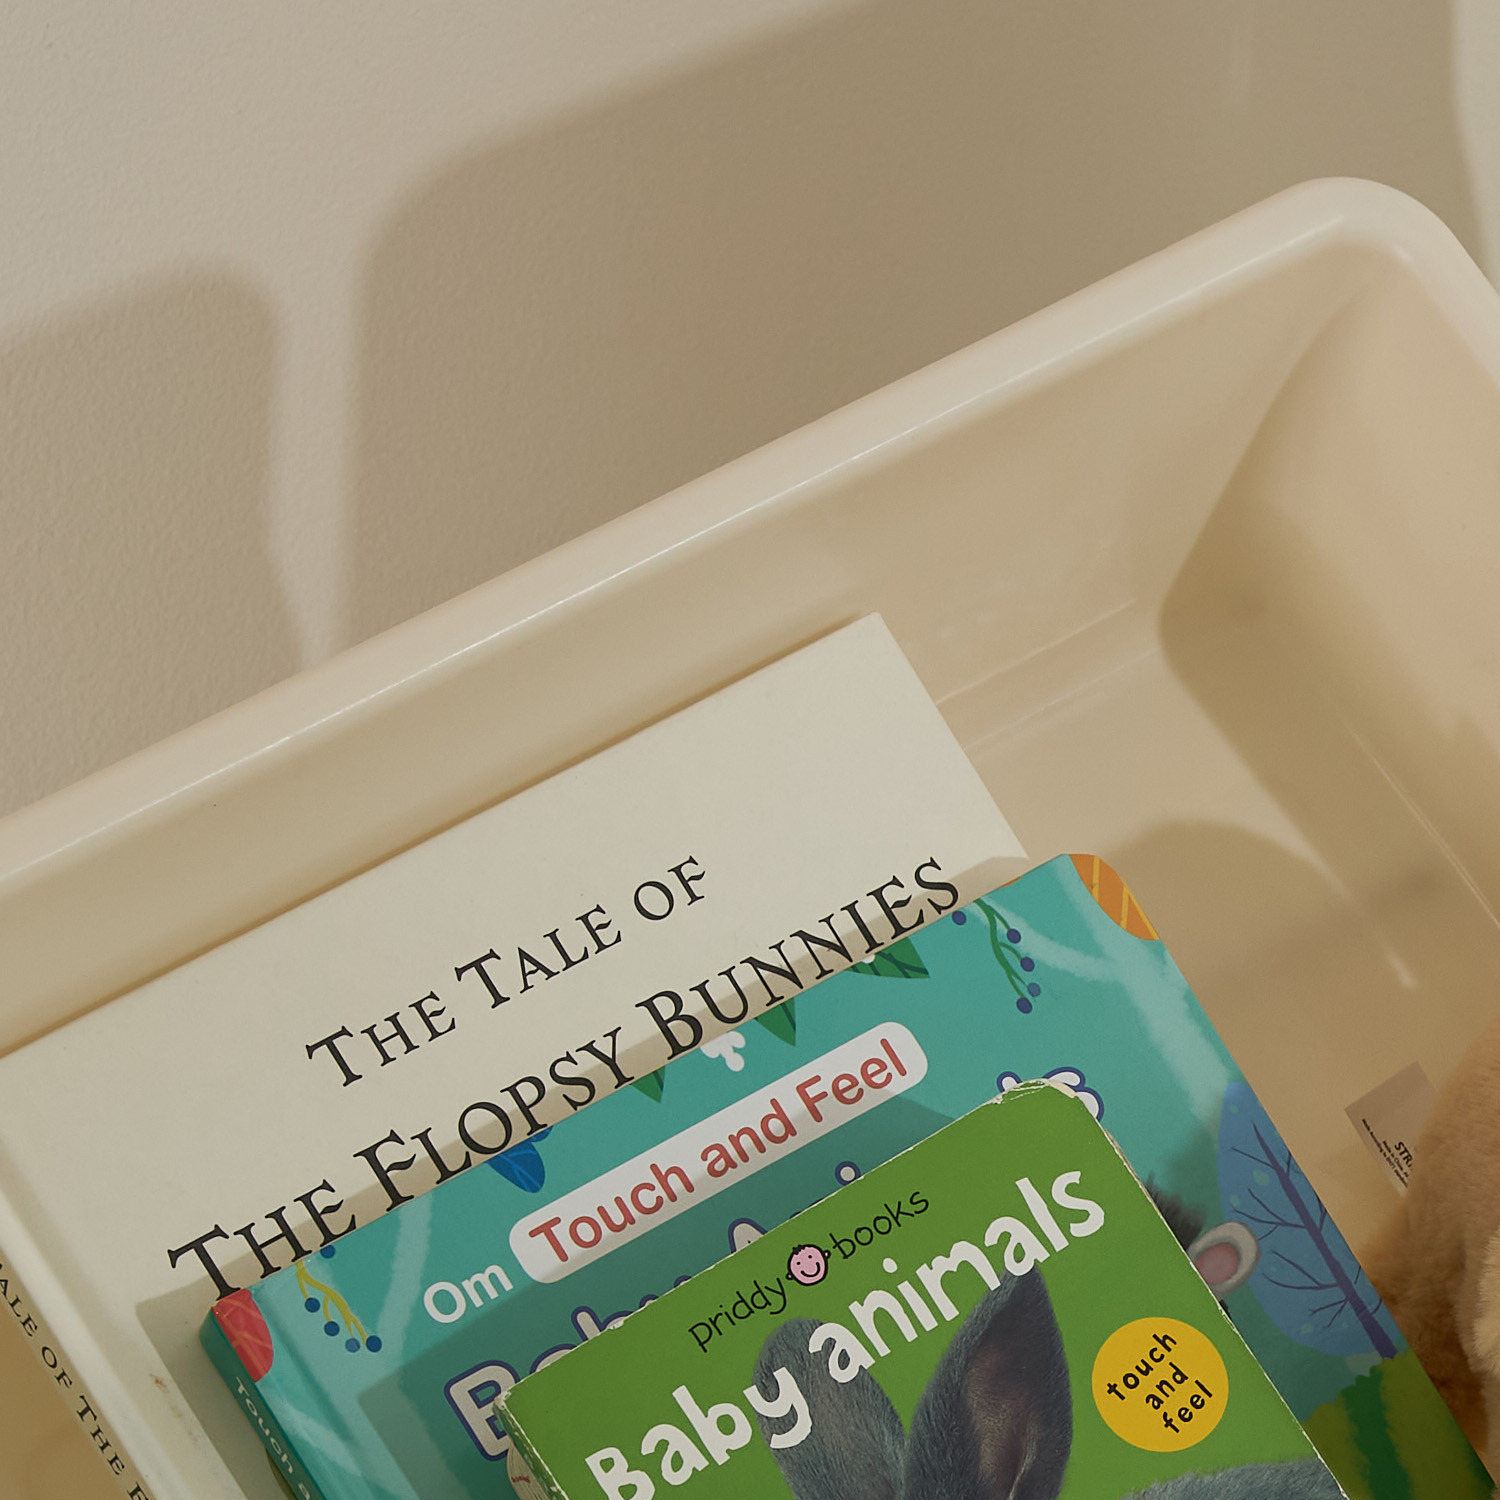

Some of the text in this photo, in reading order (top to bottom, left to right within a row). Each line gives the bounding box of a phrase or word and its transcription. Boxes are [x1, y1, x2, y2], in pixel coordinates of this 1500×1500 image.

[305, 856, 708, 1088] THE TALE OF
[167, 1179, 359, 1301] THE
[353, 1027, 636, 1212] FLOPSY
[634, 857, 961, 1060] BUNNIES
[1395, 1142, 1413, 1168] STR
[423, 1263, 514, 1324] Om
[528, 1160, 695, 1265] Touch
[699, 1101, 798, 1179] and
[795, 1038, 909, 1124] Feel
[688, 1191, 931, 1354] priddy books
[806, 1169, 1106, 1384] animals
[0, 1262, 38, 1337] ALE
[41, 1346, 73, 1389] OF
[76, 1395, 126, 1476] THE
[233, 1376, 295, 1481] Touch
[1107, 1333, 1178, 1401] touch
[1145, 1361, 1189, 1410] and
[1162, 1379, 1214, 1434] feel
